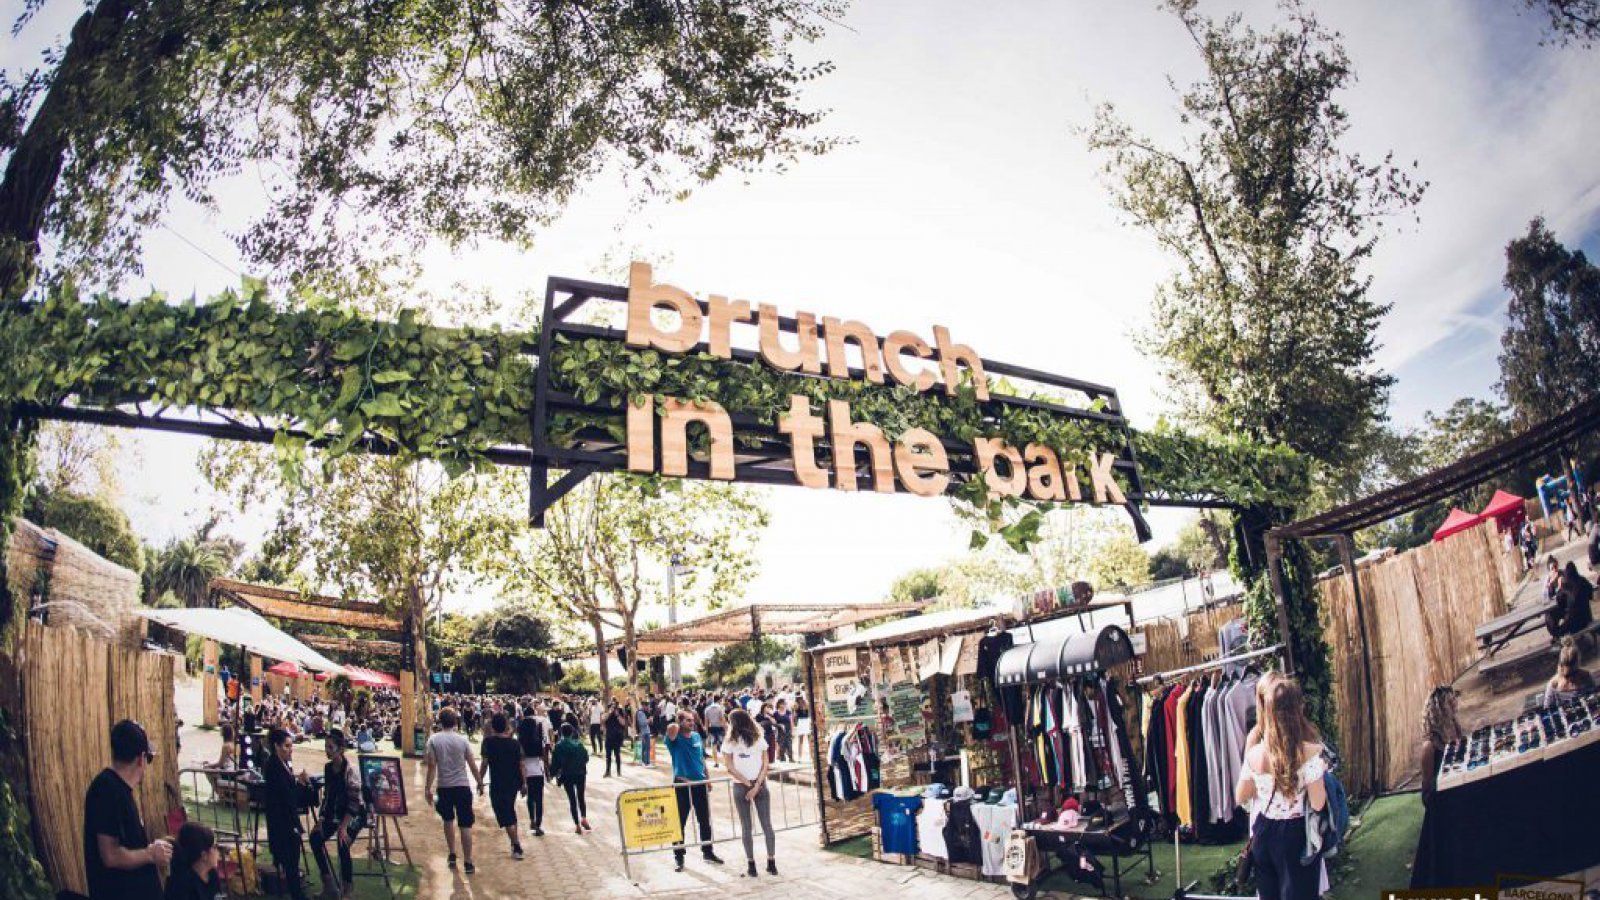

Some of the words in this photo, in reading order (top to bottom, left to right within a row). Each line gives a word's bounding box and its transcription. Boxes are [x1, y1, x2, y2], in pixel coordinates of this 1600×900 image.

[625, 262, 990, 402] brunch
[778, 394, 950, 498] the
[826, 655, 851, 667] OFFICIAL
[834, 683, 852, 695] STOR
